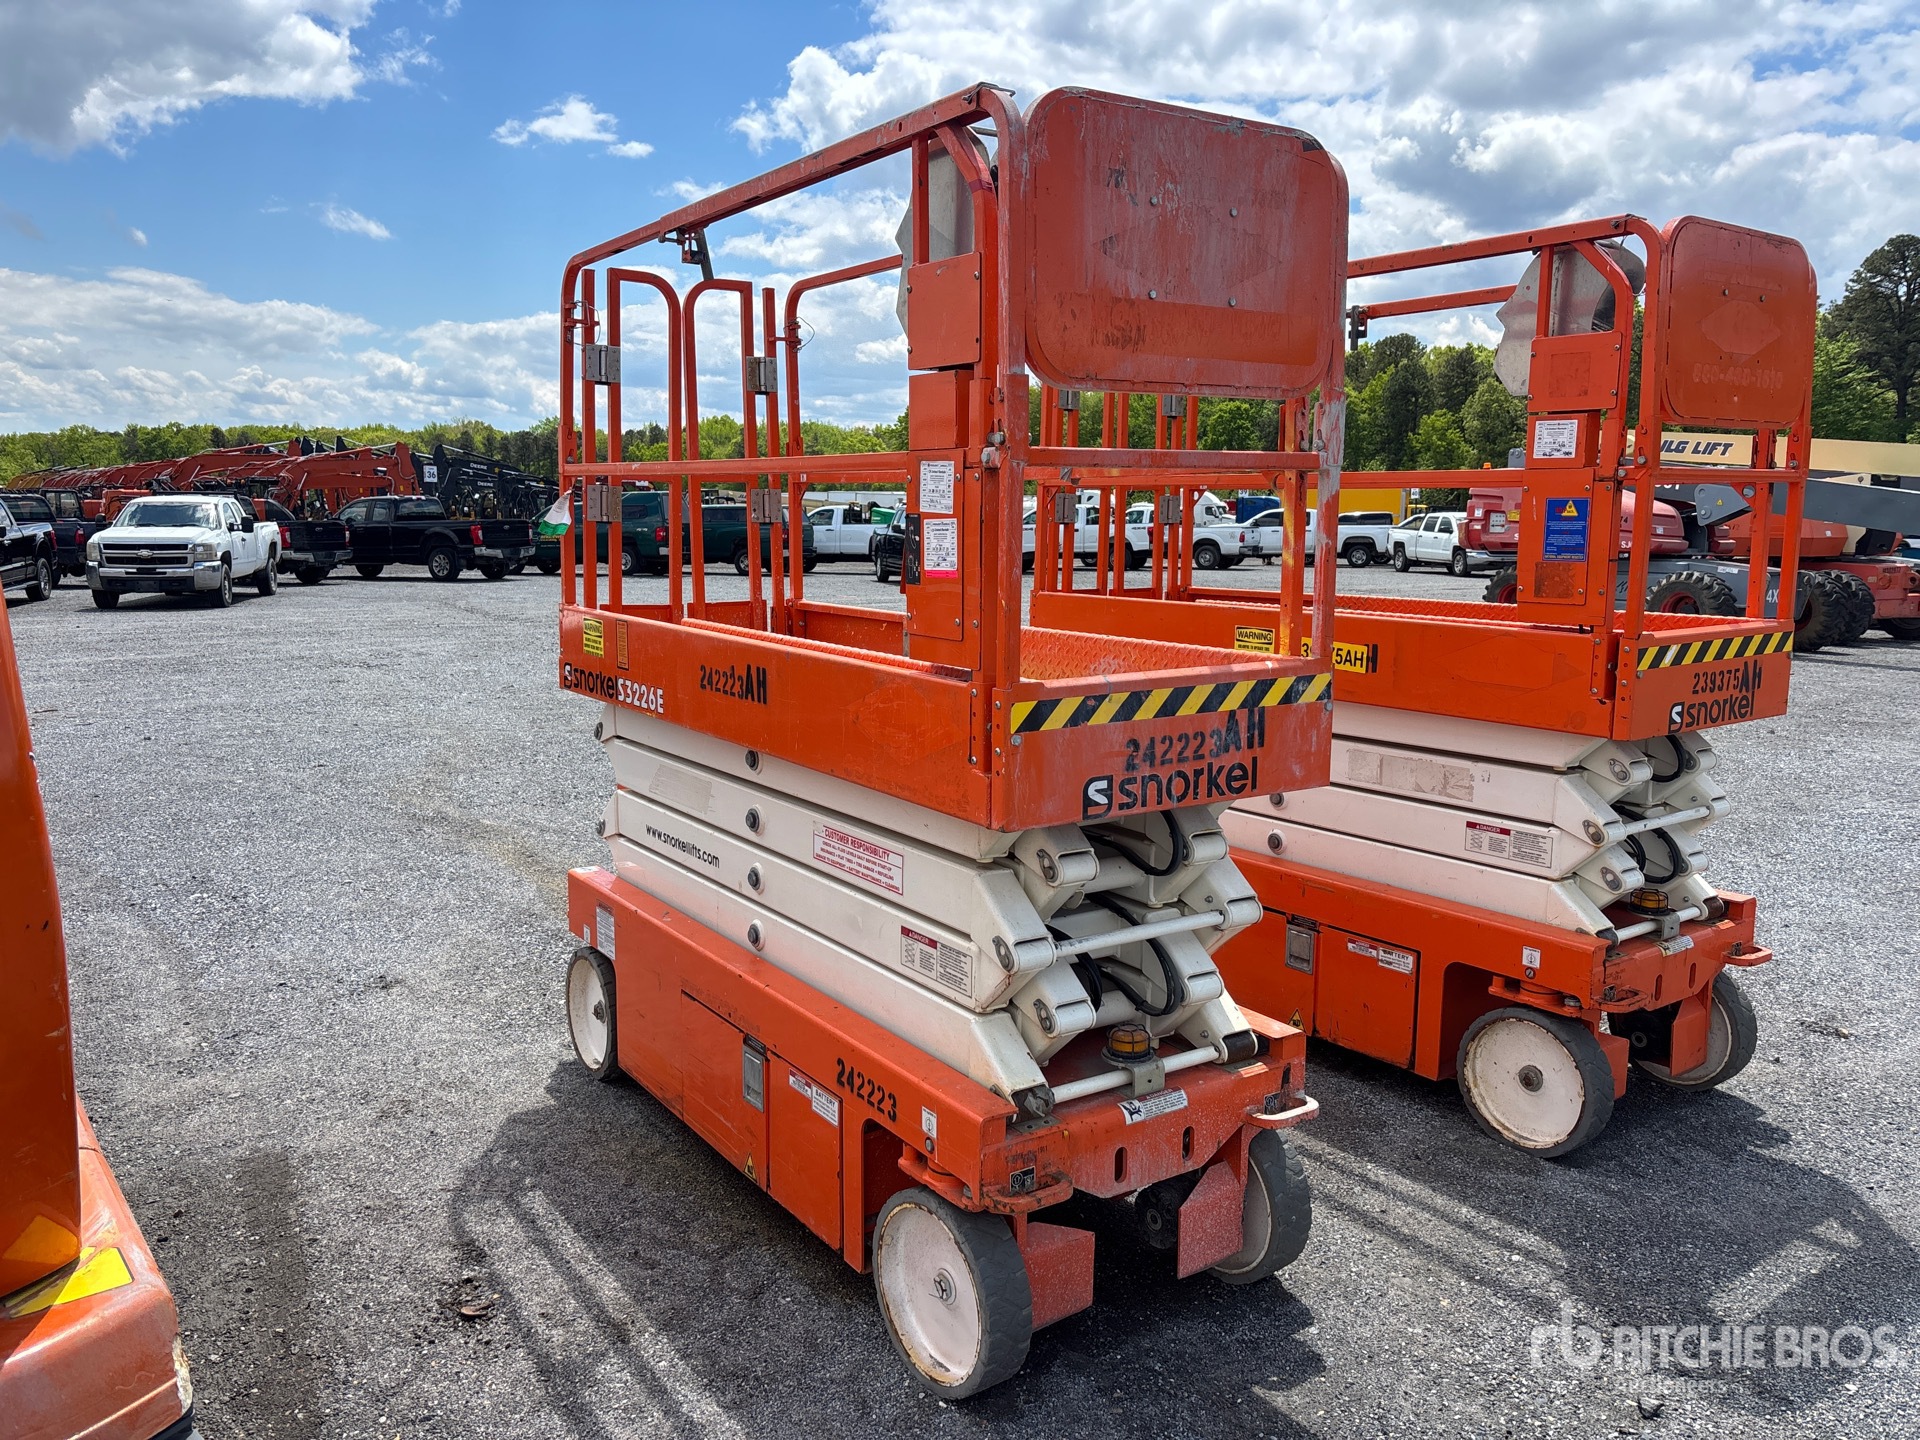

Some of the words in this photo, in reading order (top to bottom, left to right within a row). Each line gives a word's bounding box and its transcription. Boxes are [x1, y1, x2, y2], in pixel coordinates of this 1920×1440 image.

[1691, 441, 1734, 456] LIFT
[427, 470, 437, 478] 36
[470, 462, 488, 470] DEERE
[584, 622, 602, 634] WARNING
[1238, 630, 1272, 641] WARNING
[573, 667, 618, 700] snorkel
[617, 678, 664, 714] S3226E
[1685, 690, 1755, 728] snorkel
[1118, 756, 1258, 811] snorkel
[1480, 825, 1500, 833] DANGER
[646, 824, 720, 869] www.snorkellifts.com
[825, 829, 849, 845] CUSTOMER
[850, 839, 889, 861] RESPONSIBILITY
[912, 931, 929, 944] DANGER
[815, 1088, 836, 1107] BATTERY
[837, 1057, 897, 1123] 242223
